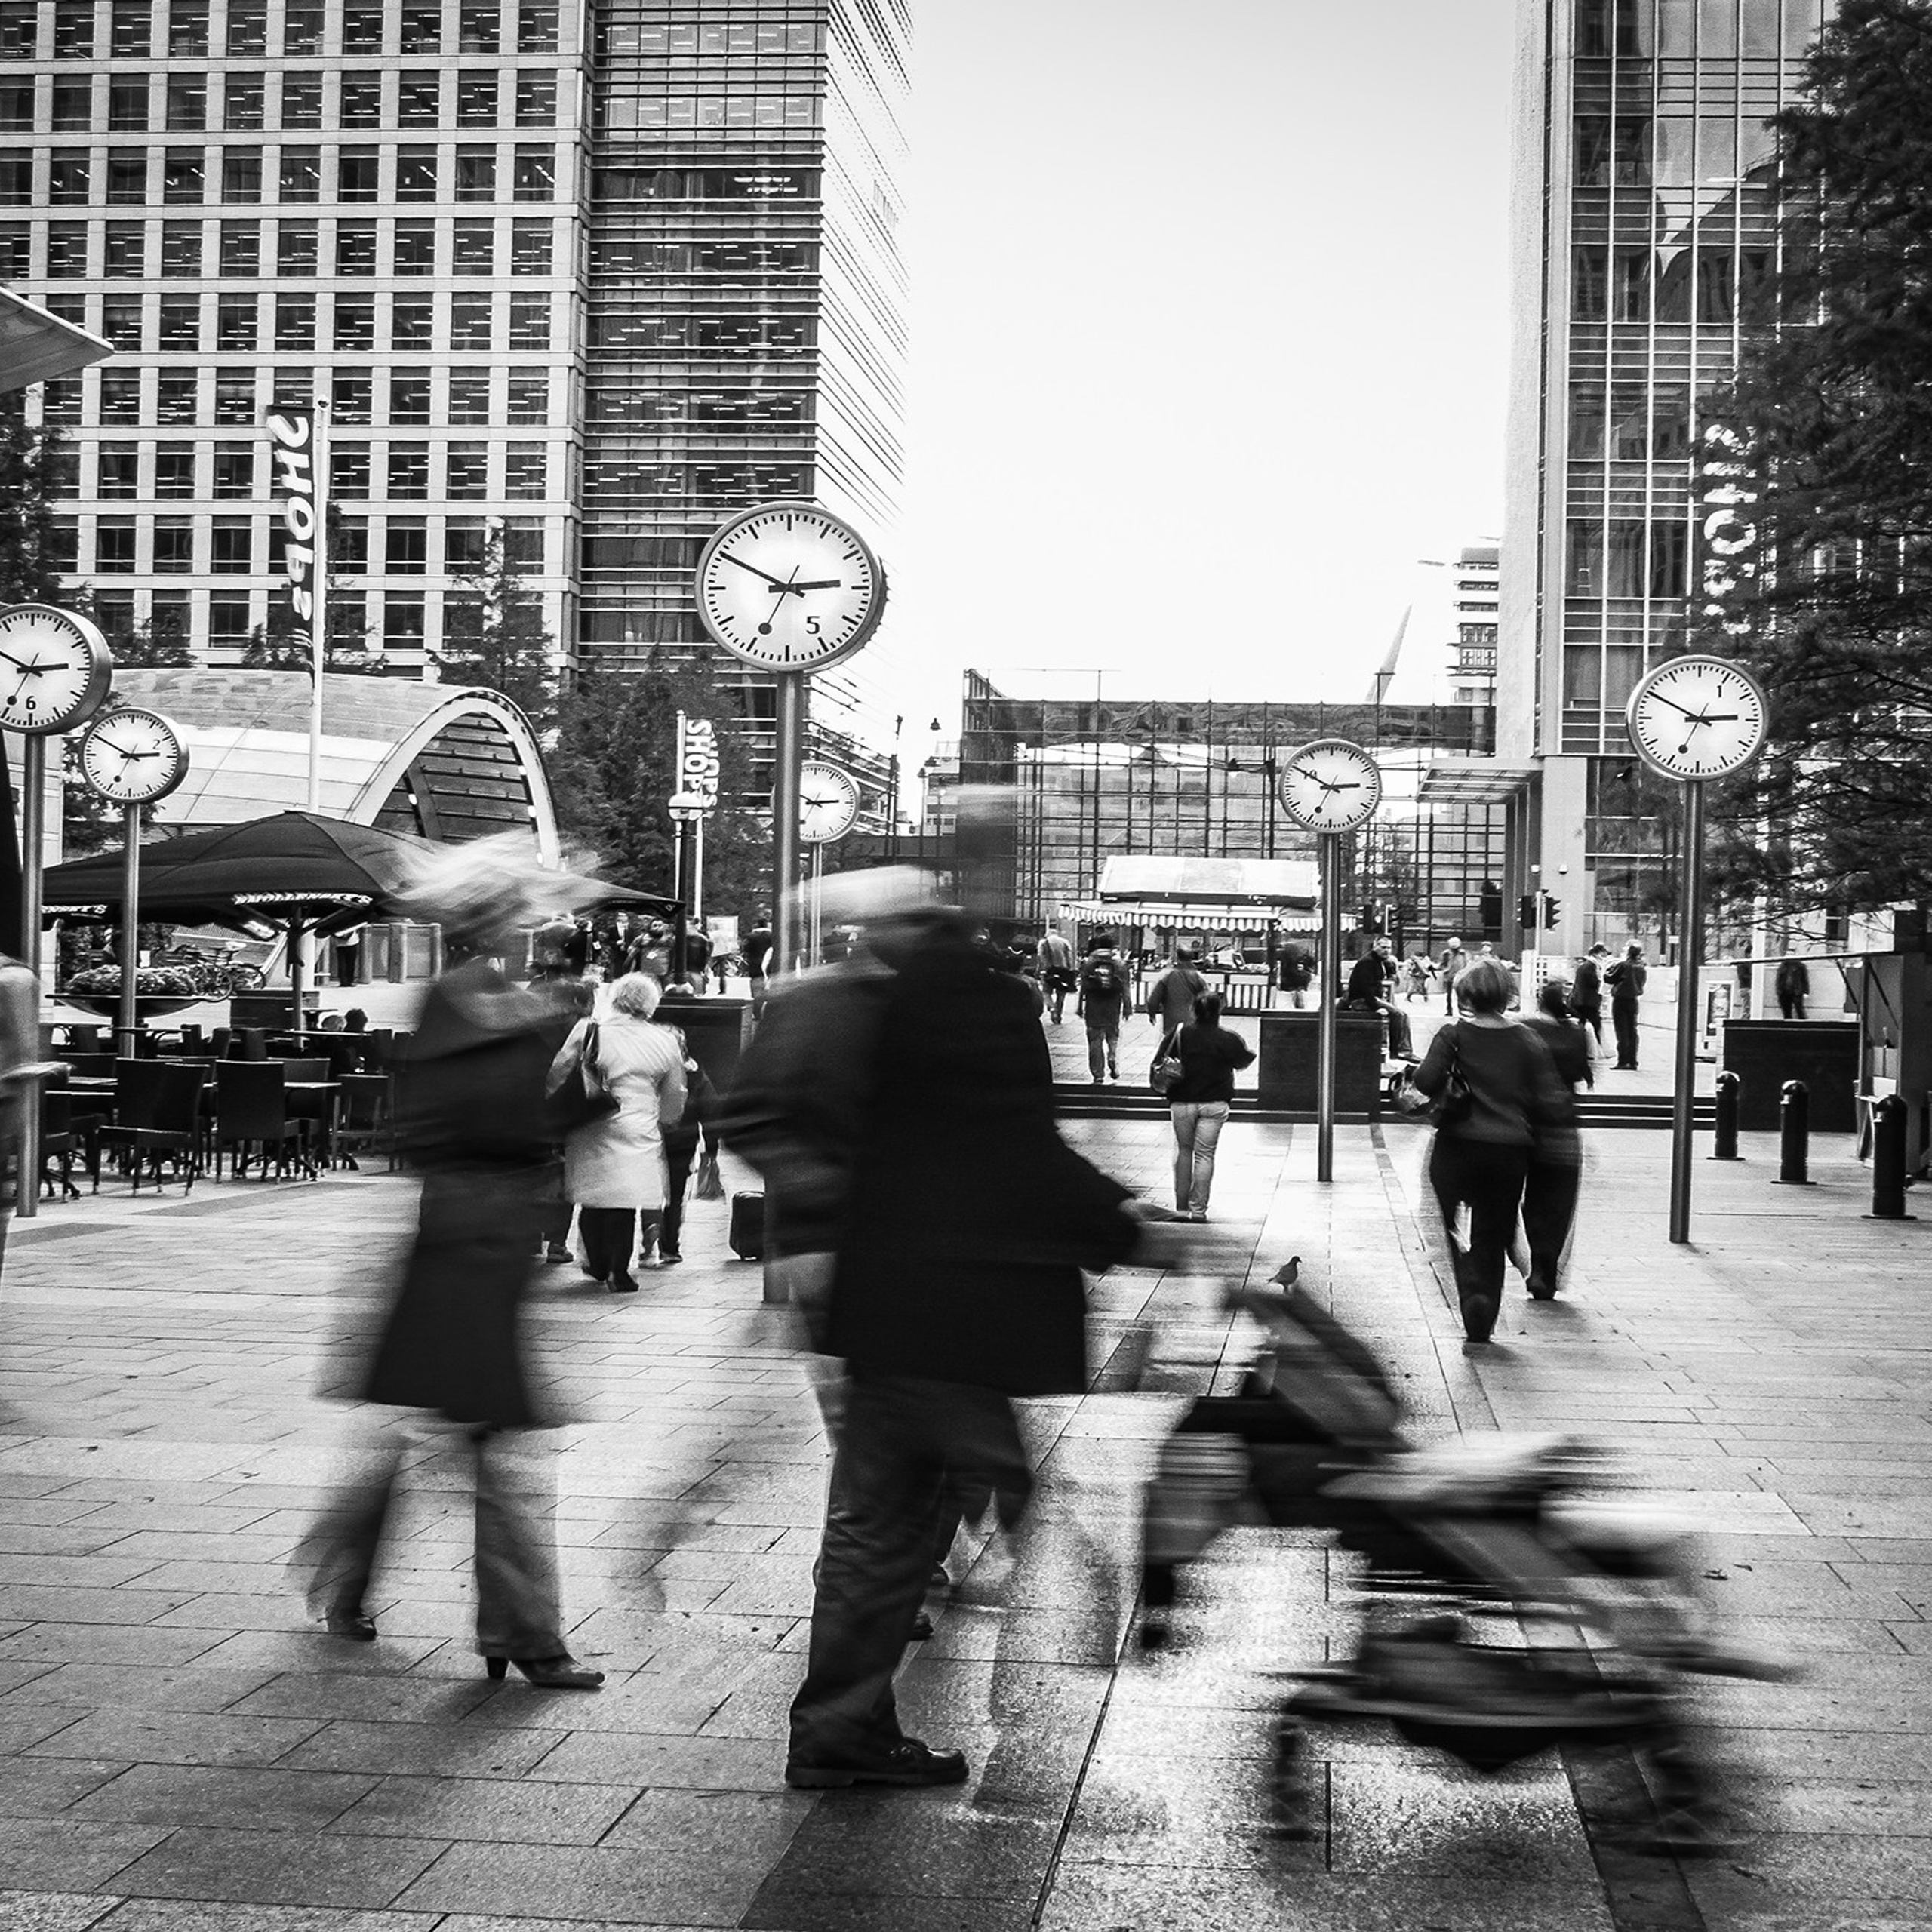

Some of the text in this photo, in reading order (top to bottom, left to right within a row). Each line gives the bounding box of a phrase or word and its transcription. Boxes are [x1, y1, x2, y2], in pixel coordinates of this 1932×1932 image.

[806, 616, 820, 635] 5
[1716, 685, 1723, 698] 1
[26, 695, 36, 710] 6
[152, 739, 161, 749] 2
[685, 719, 712, 790] SHOP
